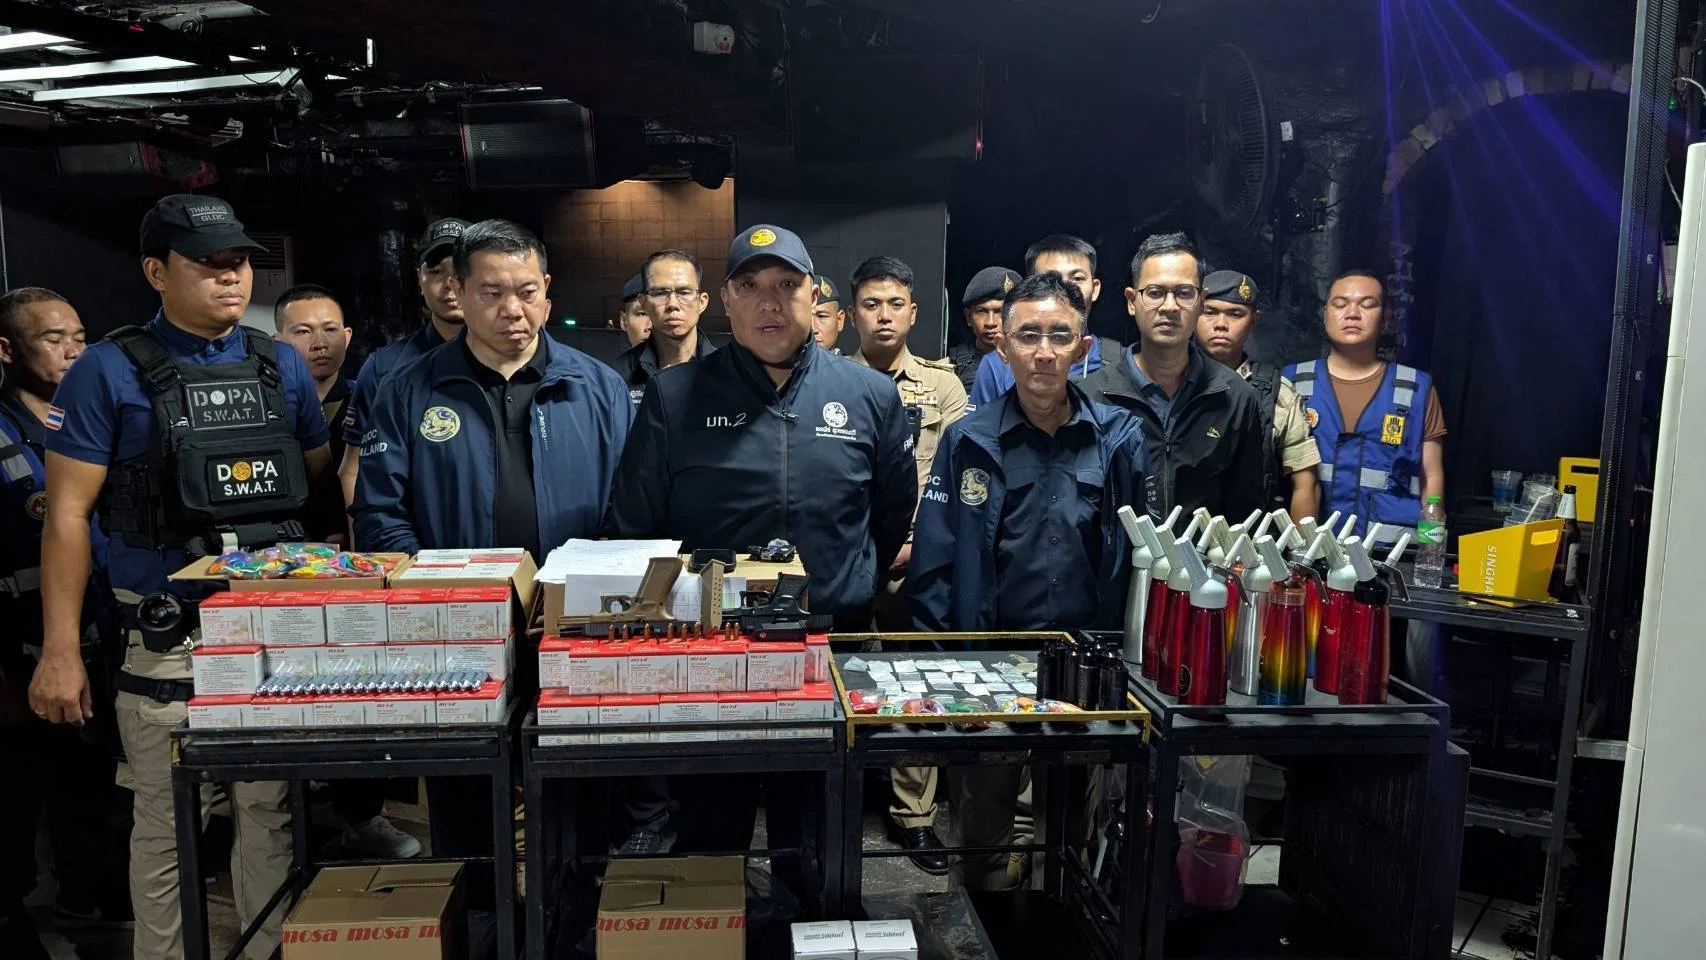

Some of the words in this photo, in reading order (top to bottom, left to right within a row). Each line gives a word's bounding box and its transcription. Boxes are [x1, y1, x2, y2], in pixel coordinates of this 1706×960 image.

[193, 388, 257, 407] DOPA
[203, 407, 255, 422] S.W.A.T.
[216, 460, 279, 481] DOPA
[223, 480, 277, 497] S.W.A.T.
[1484, 544, 1497, 596] SINGHA
[653, 916, 719, 930] mosa
[346, 925, 410, 941] mosa
